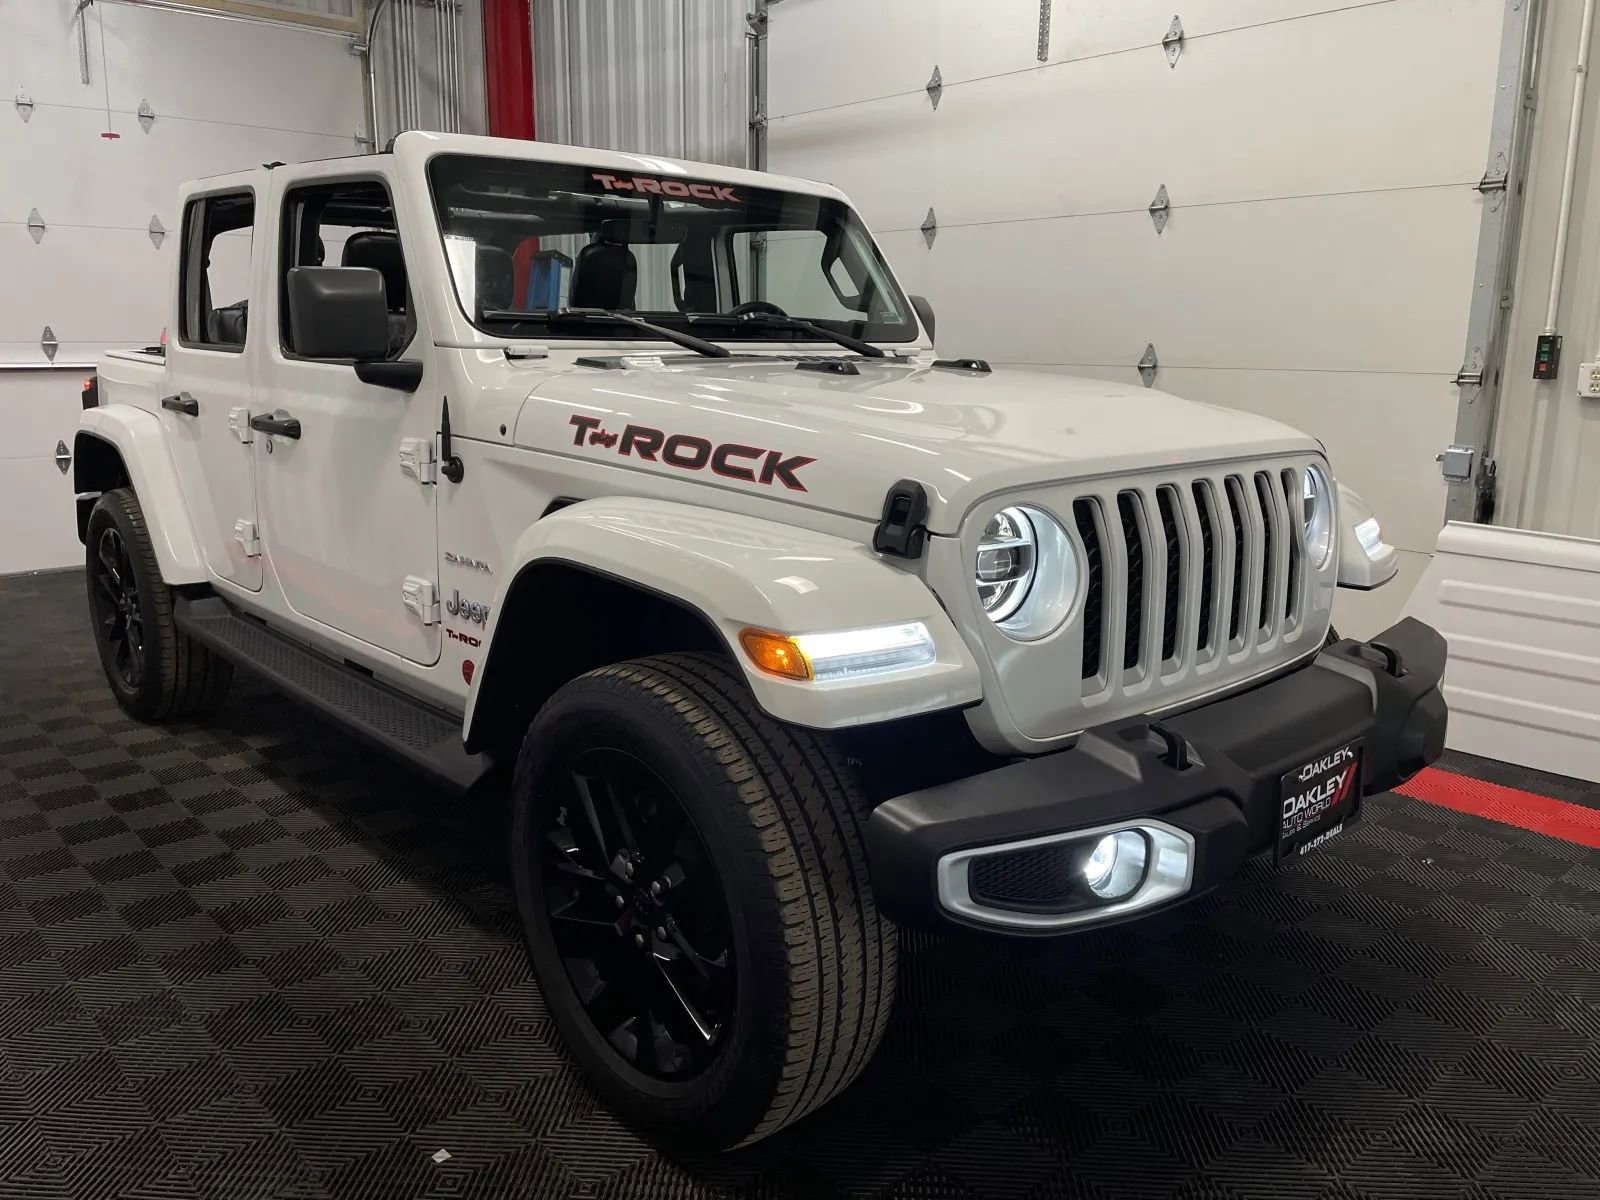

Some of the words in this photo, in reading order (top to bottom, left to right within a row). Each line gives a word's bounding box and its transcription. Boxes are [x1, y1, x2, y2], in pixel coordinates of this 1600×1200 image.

[1302, 746, 1350, 781] OAKLEY
[1283, 770, 1348, 819] OAKLEY
[1282, 811, 1304, 829] AUTO
[1305, 796, 1331, 819] WORLD
